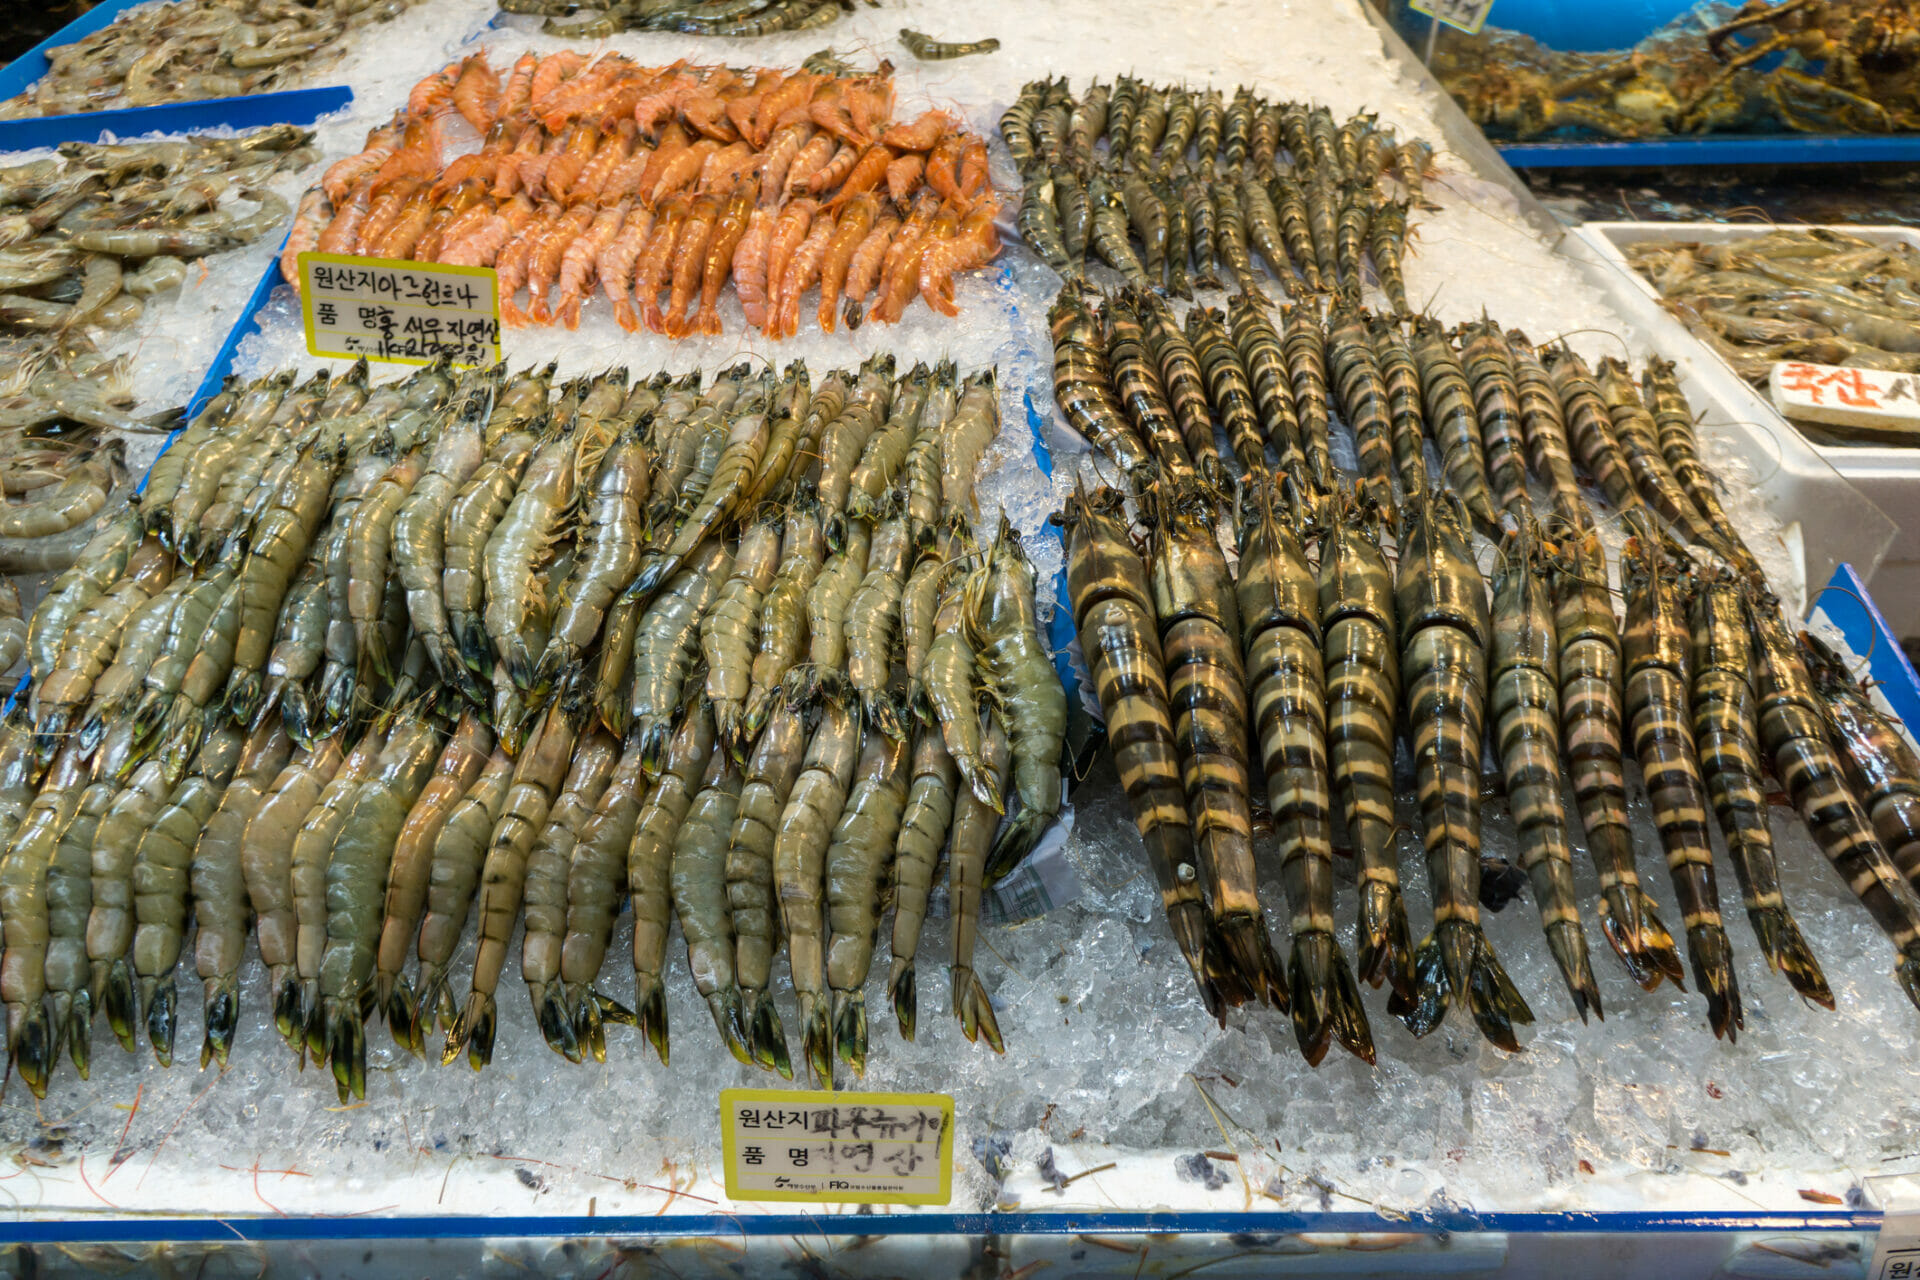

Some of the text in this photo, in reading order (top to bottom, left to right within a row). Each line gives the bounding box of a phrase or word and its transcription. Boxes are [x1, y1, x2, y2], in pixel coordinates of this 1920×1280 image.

[314, 266, 376, 293] 원산지
[317, 303, 338, 325] 품
[359, 307, 376, 329] 명
[1780, 363, 1884, 409] 국산
[739, 1109, 809, 1130] 원산지
[742, 1146, 766, 1165] 품
[789, 1147, 809, 1167] 명
[829, 1180, 850, 1190] FIQ
